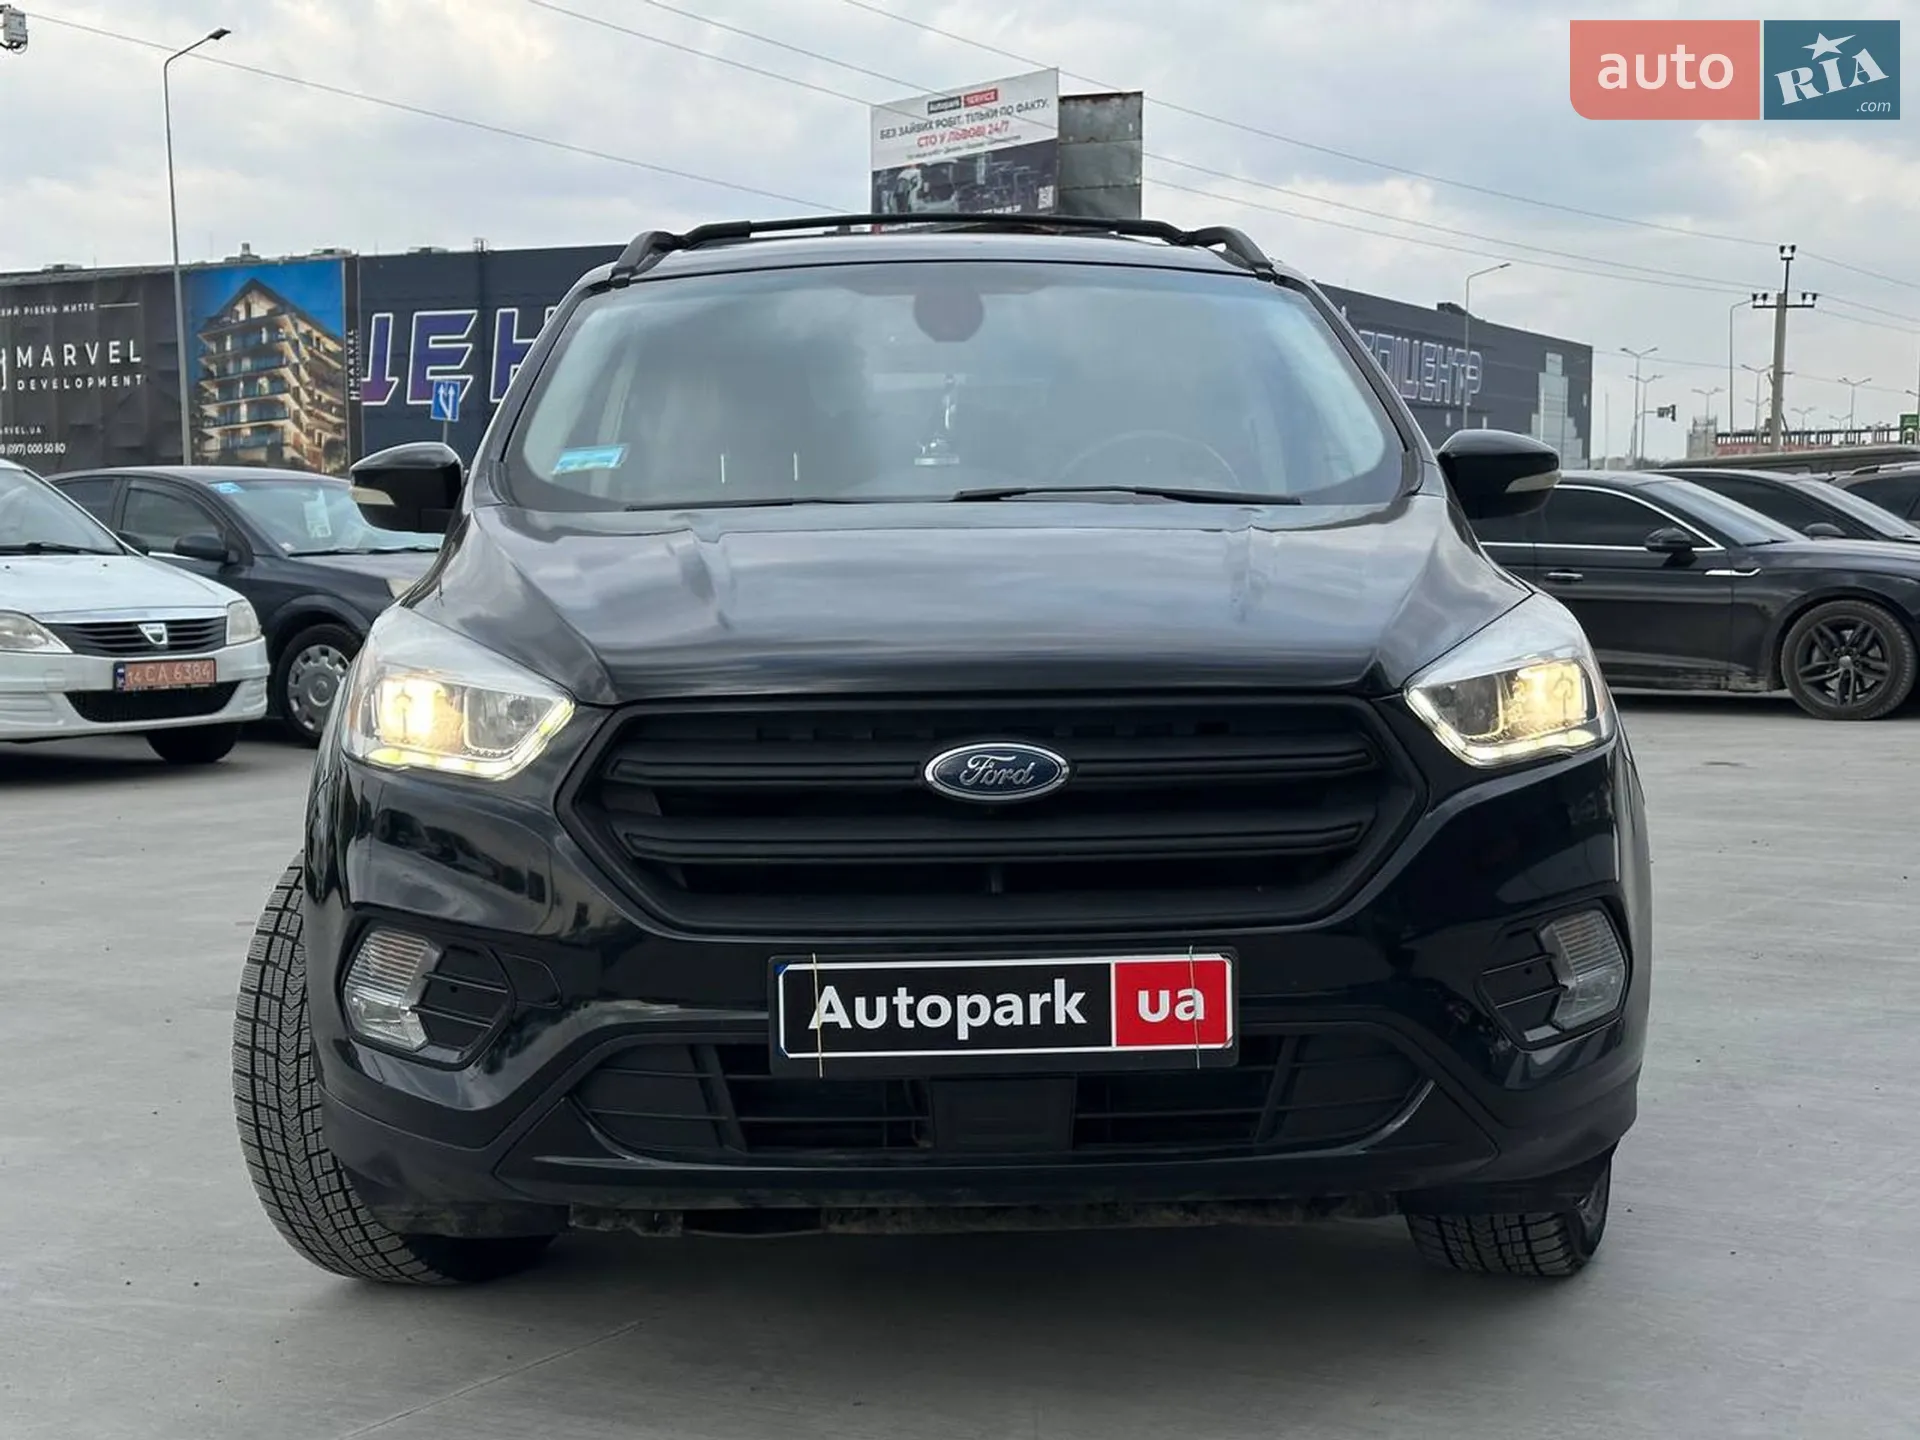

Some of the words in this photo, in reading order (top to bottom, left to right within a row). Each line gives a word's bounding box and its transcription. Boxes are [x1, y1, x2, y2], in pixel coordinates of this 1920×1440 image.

[880, 126, 897, 140] БЕЗ
[899, 119, 934, 137] ЗАЙВИХ
[966, 109, 999, 125] ТІЛЬКИ
[999, 105, 1014, 118] ПО
[1016, 99, 1050, 114] ФАКТУ.
[917, 133, 938, 148] СТО
[946, 126, 986, 143] ЛЬВОВІ
[988, 121, 1010, 135] 24/7
[24, 305, 58, 316] РІВЕНЬ
[62, 303, 95, 313] ЖИТТЯ
[16, 339, 142, 368] MARVEL
[346, 328, 355, 388] MARVEL
[17, 374, 142, 391] DEVELOPMENT
[27, 443, 43, 454] 000
[44, 442, 53, 454] 50
[54, 442, 66, 454] 80
[959, 754, 1036, 786] Ford
[808, 978, 1087, 1041] Autopark
[1137, 987, 1206, 1024] ua
